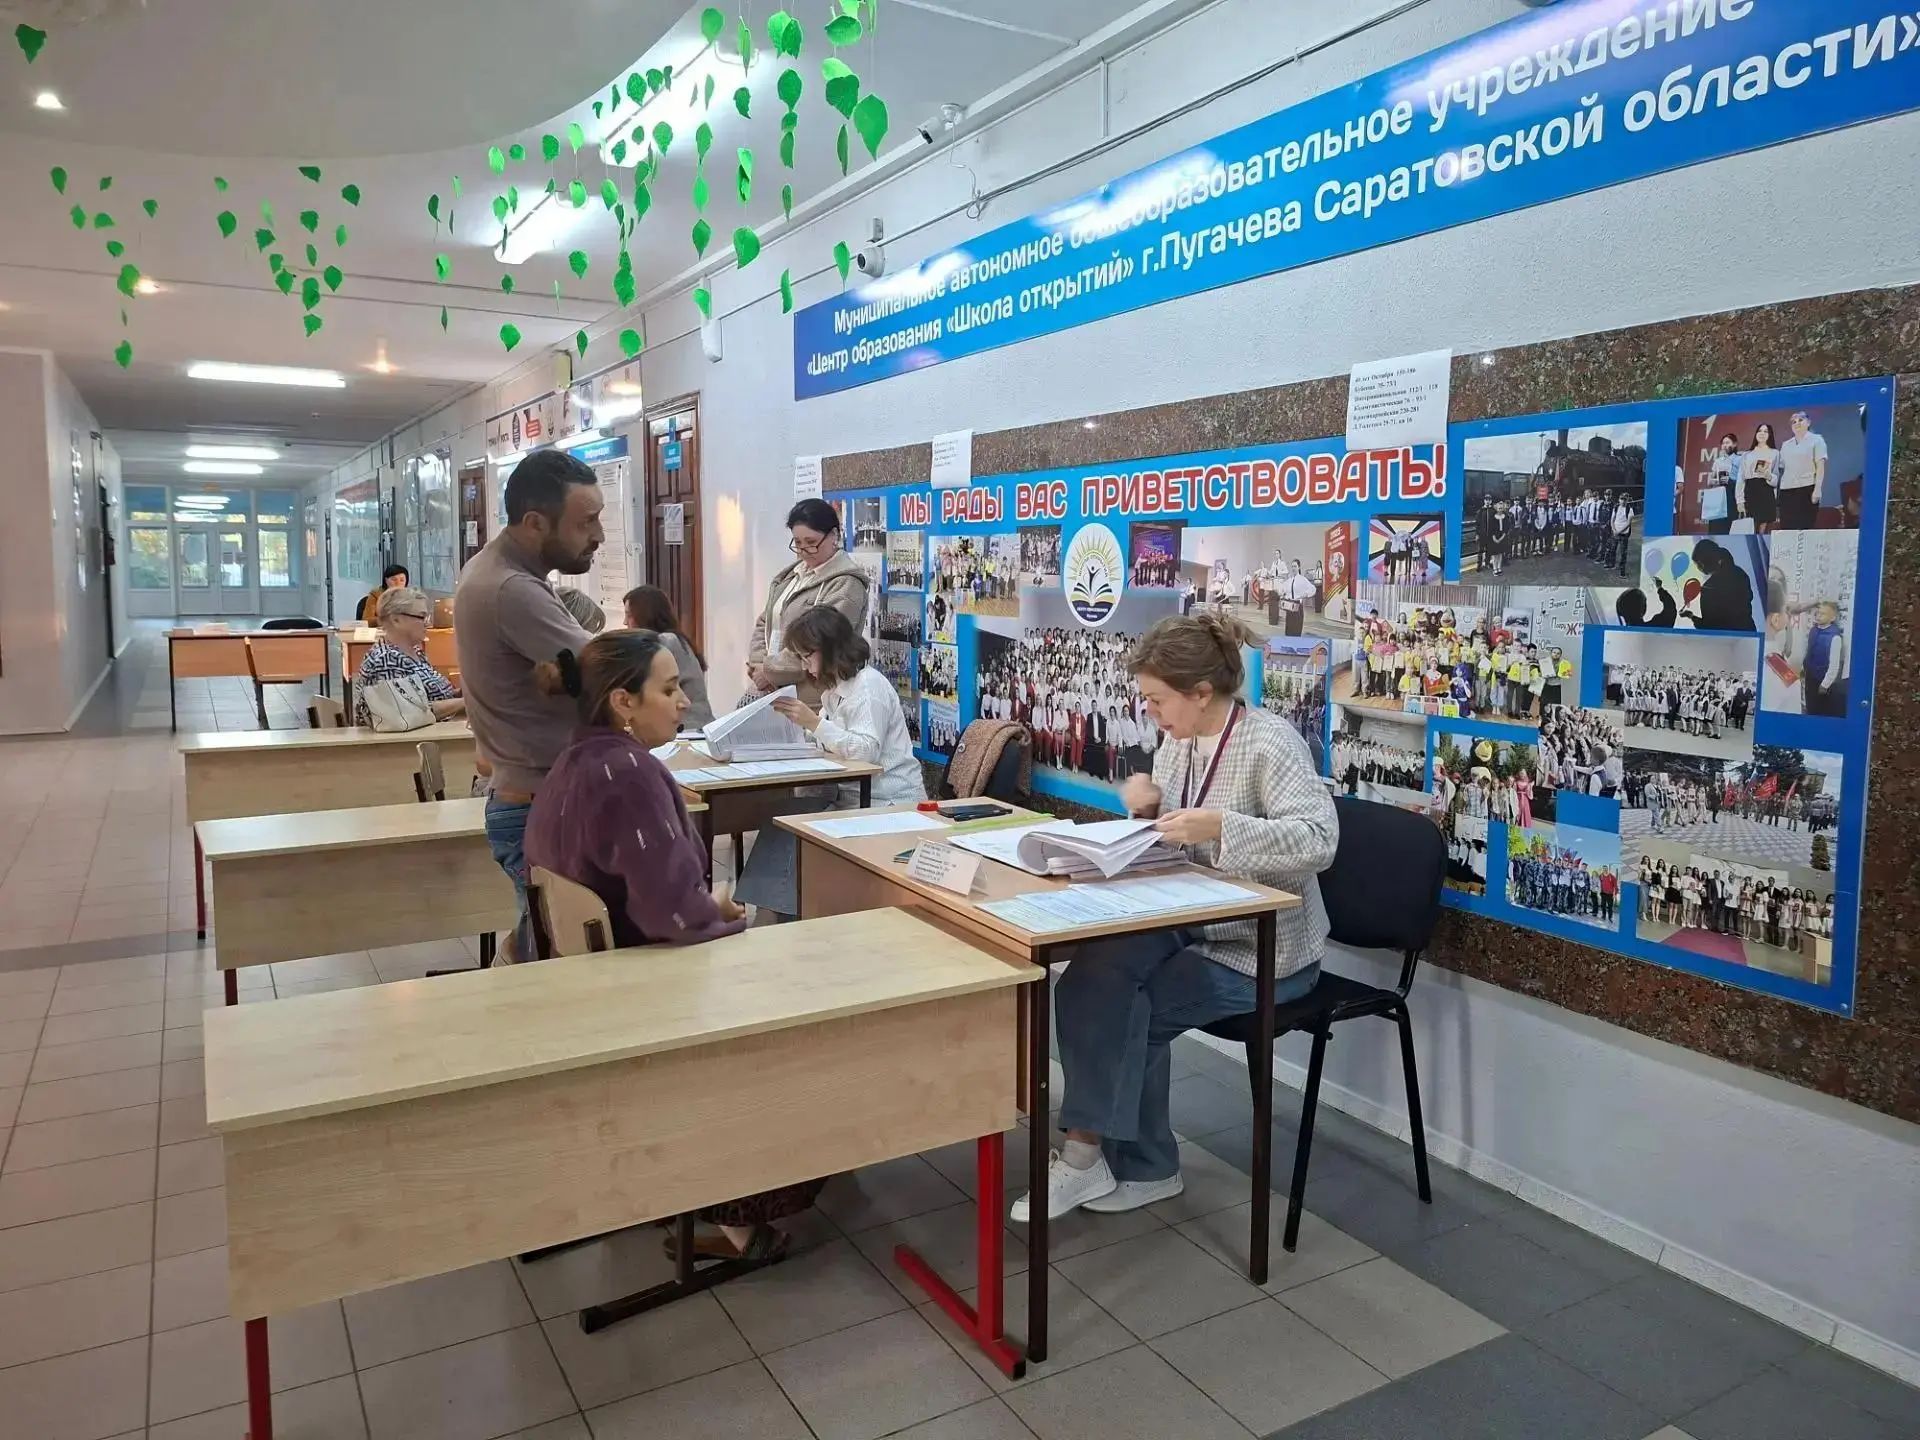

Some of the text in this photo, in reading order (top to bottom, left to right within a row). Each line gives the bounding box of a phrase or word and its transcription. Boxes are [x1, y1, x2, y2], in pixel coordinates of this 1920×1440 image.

[807, 13, 1920, 376] «Центр образования «Школа открытий» г.Пугачева Саратовской области»
[834, 278, 946, 336] Муниципальное
[951, 230, 1064, 294] автономное
[900, 443, 1446, 527] МЫ РАДЫ ВАС ПРИВЕТСТВОВАТЬ!
